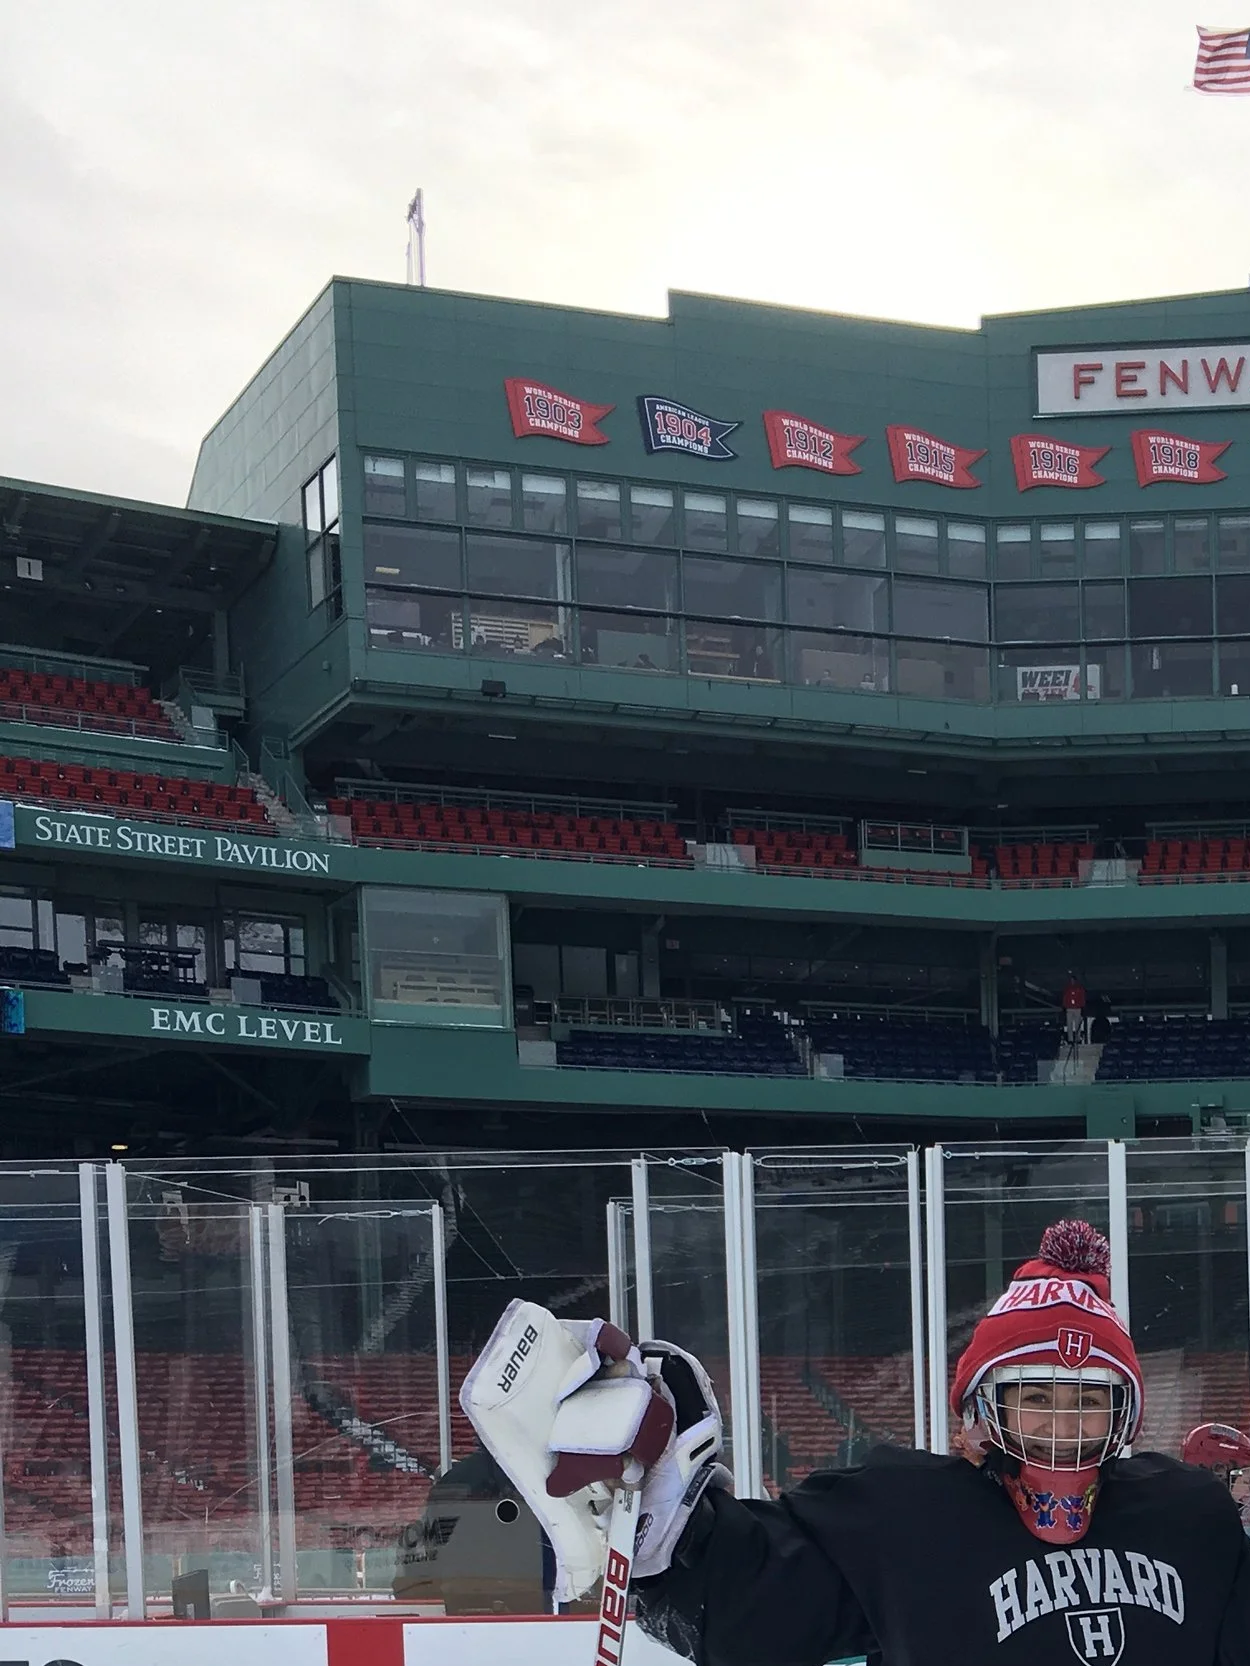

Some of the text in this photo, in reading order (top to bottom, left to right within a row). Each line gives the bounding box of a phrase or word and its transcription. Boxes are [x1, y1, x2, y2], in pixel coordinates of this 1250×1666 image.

[523, 386, 581, 411] WORLD SERIES
[655, 404, 686, 416] AMERICAN
[523, 394, 584, 431] 1903
[529, 417, 580, 438] CHAMPIONS
[654, 410, 712, 447] 1904
[781, 418, 834, 441] WORLD SERIES
[659, 434, 709, 454] CHAMPIONS
[783, 426, 834, 461] 1912
[903, 433, 956, 456] WORLD SERIES
[1028, 441, 1080, 457] WORLD SERIES
[1148, 436, 1200, 451] WORLD SERIES
[786, 448, 833, 469] CHAMPIONS
[905, 441, 956, 475] 1915
[1030, 448, 1079, 476] 1916
[1149, 443, 1200, 471] 1918
[908, 462, 954, 482] CHAMPIONS
[1032, 470, 1079, 483] CHAMPIONS
[1152, 465, 1198, 479] CHAMPIONS
[1021, 669, 1073, 688] WEEI
[35, 816, 330, 873] STATE STREET PAVILION
[150, 1007, 343, 1045] EMC LEVEL
[1065, 1333, 1084, 1358] H
[47, 1570, 95, 1589] Frozen
[54, 1586, 93, 1594] FENWAY
[989, 1548, 1185, 1643] HARVARD
[1079, 1615, 1115, 1658] H
